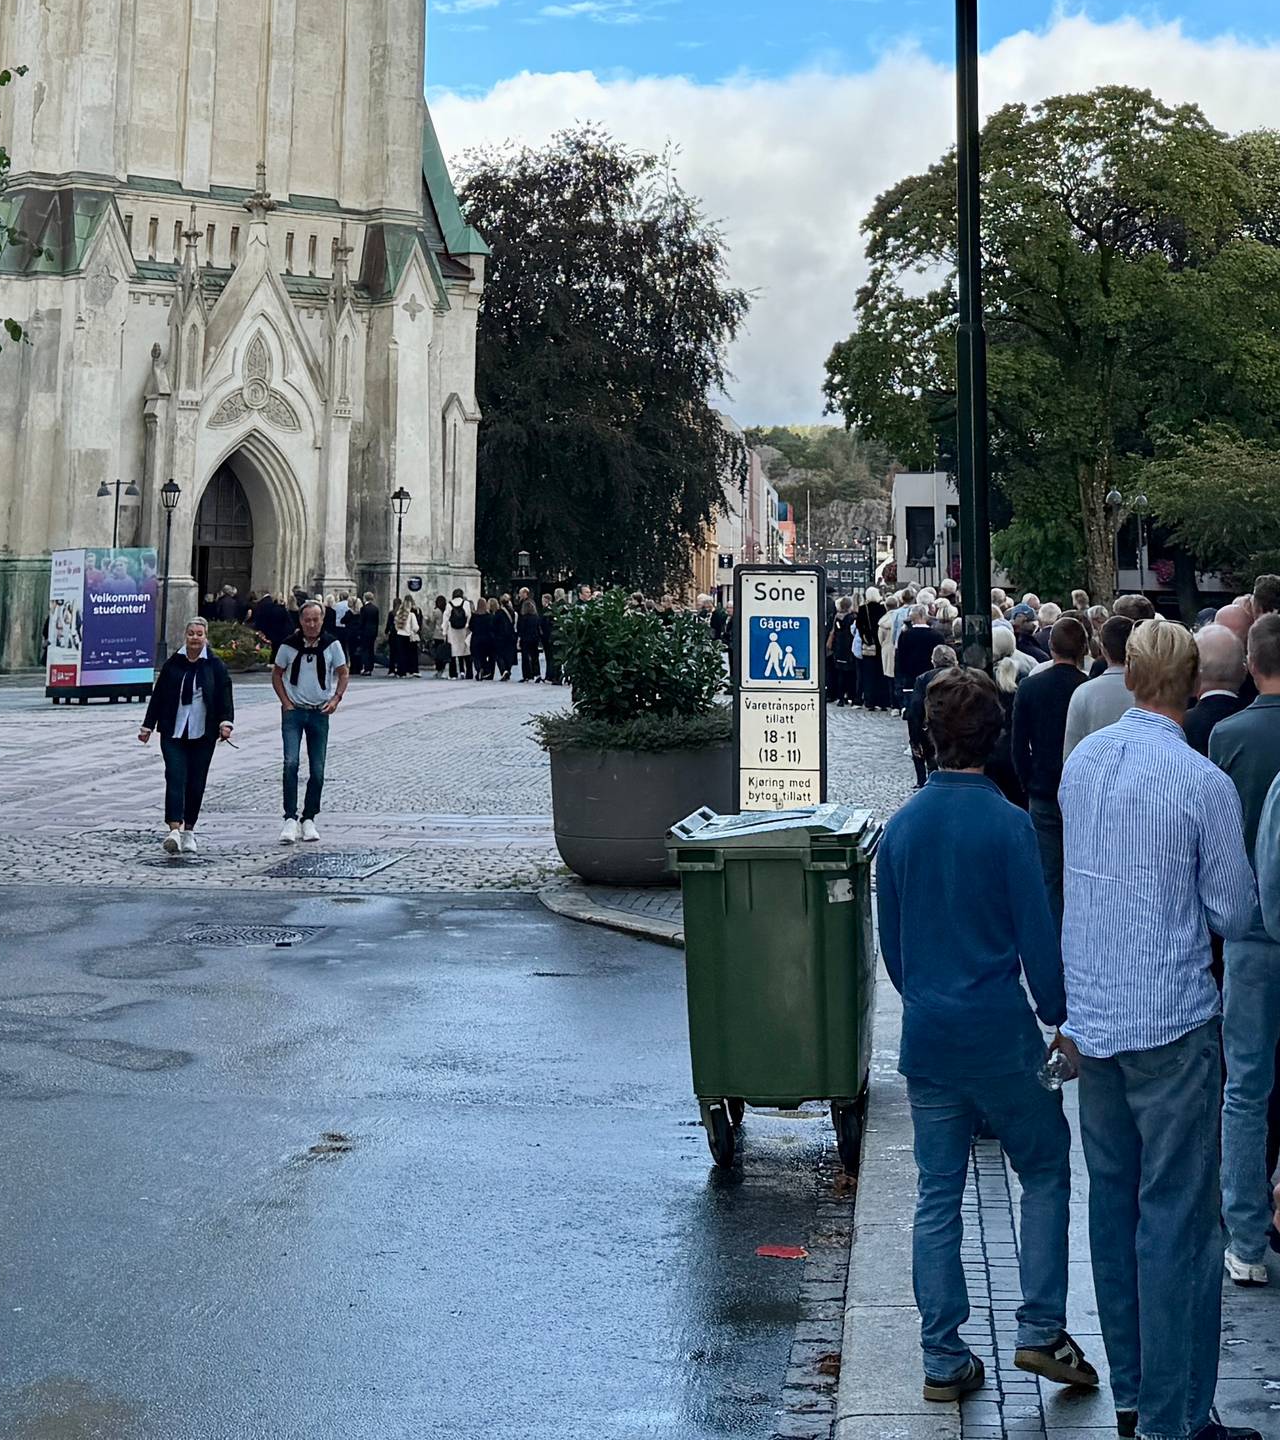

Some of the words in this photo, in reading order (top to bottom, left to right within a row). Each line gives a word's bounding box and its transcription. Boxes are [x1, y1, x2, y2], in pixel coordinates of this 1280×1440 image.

[754, 582, 806, 601] Sone
[89, 593, 151, 603] Velkommen
[93, 603, 146, 615] studenter!
[759, 617, 800, 632] Gågate
[745, 700, 815, 713] Varetransport
[766, 714, 794, 724] tillatt
[748, 776, 784, 790] Kjøring
[789, 778, 811, 788] med
[748, 791, 778, 803] bytog
[782, 791, 811, 802] tillatt
